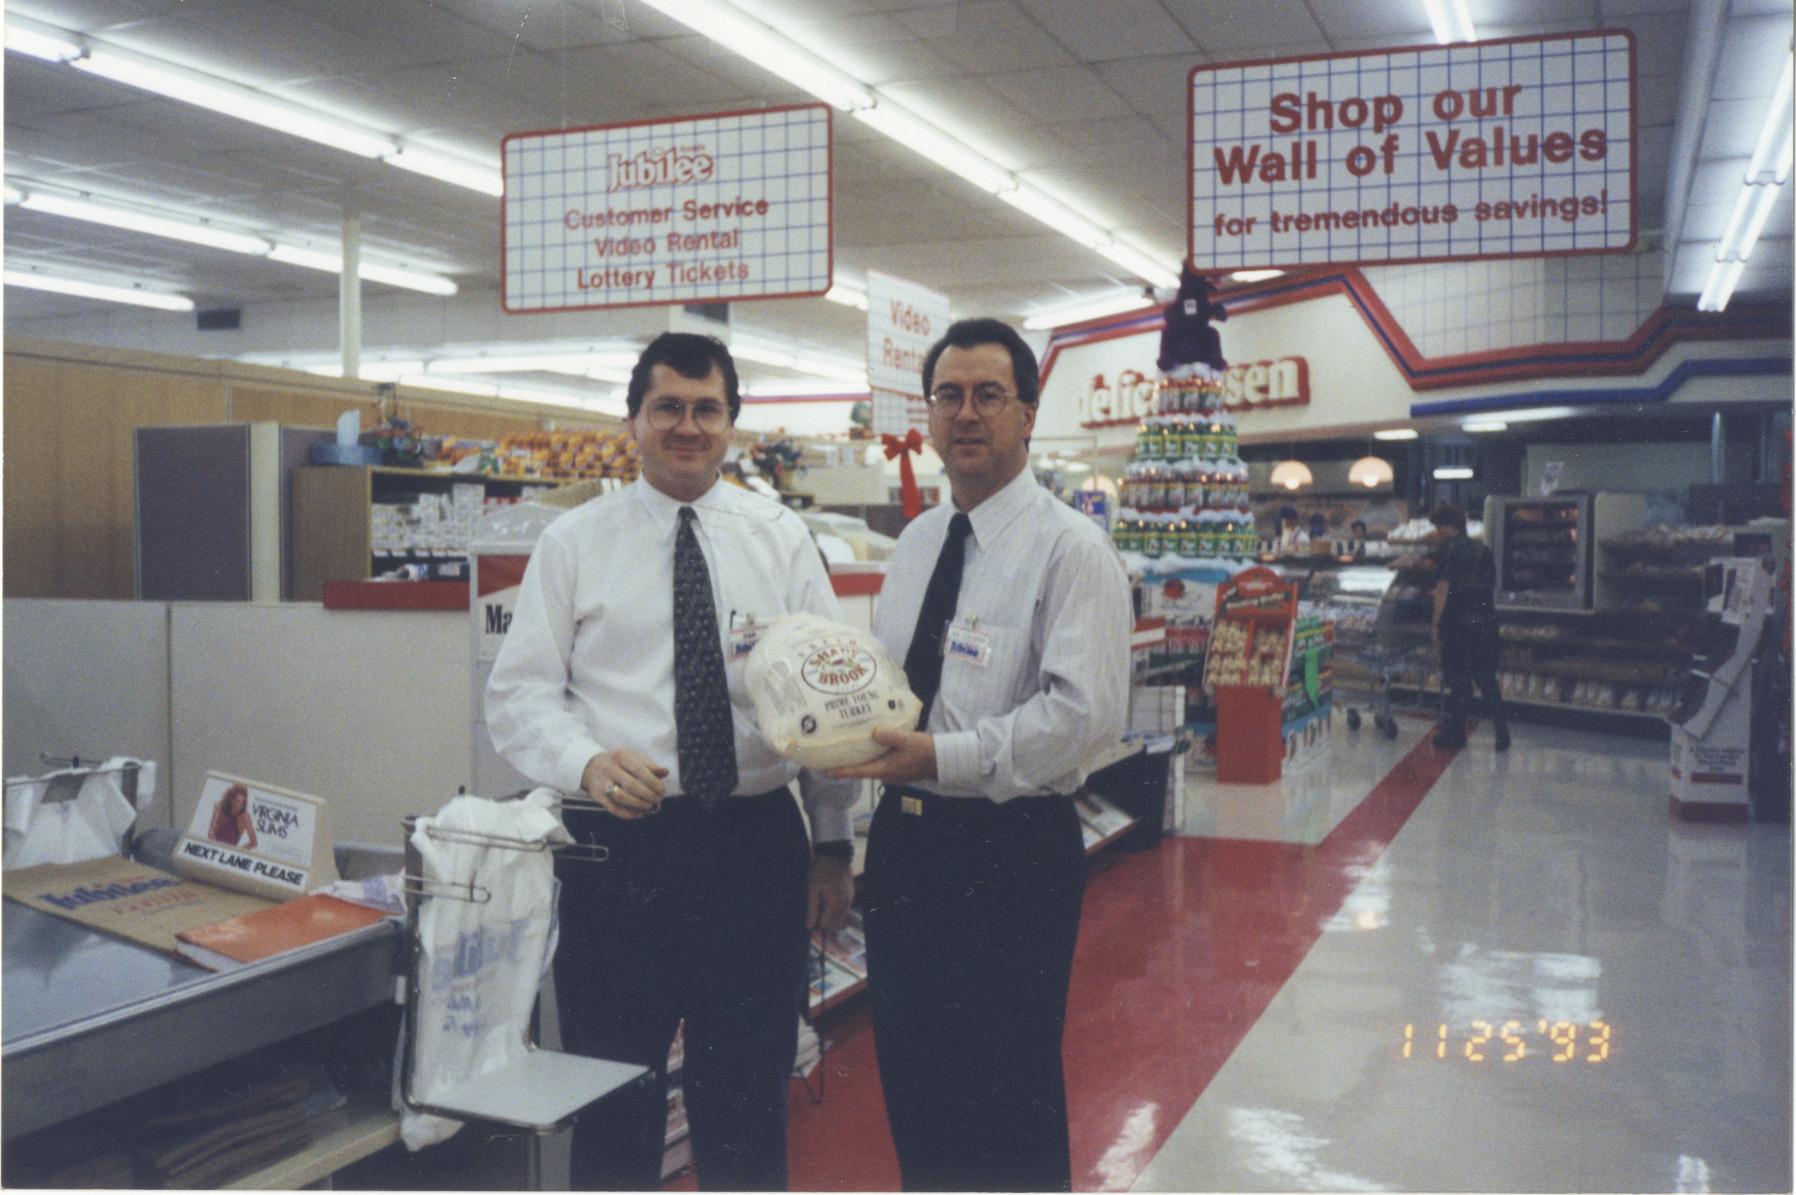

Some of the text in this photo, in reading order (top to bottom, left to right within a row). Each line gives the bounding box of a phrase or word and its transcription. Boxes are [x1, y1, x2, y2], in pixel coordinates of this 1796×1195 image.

[1269, 84, 1522, 134] Shop our
[606, 146, 714, 194] Jubilee
[1213, 126, 1608, 186] Wall of Values
[563, 196, 770, 230] Customer Service
[1213, 190, 1609, 237] for tremendous savings!
[594, 228, 739, 258] Video Rental
[577, 260, 750, 291] Lottery Tickets
[890, 299, 930, 337] Video
[883, 336, 927, 373] Renta
[818, 664, 866, 686] BROOK
[252, 801, 300, 828] VIRGINIA
[255, 819, 288, 840] SLIMS
[184, 842, 220, 861] NEXT
[218, 852, 254, 872] LANE
[253, 861, 305, 886] PLEASE
